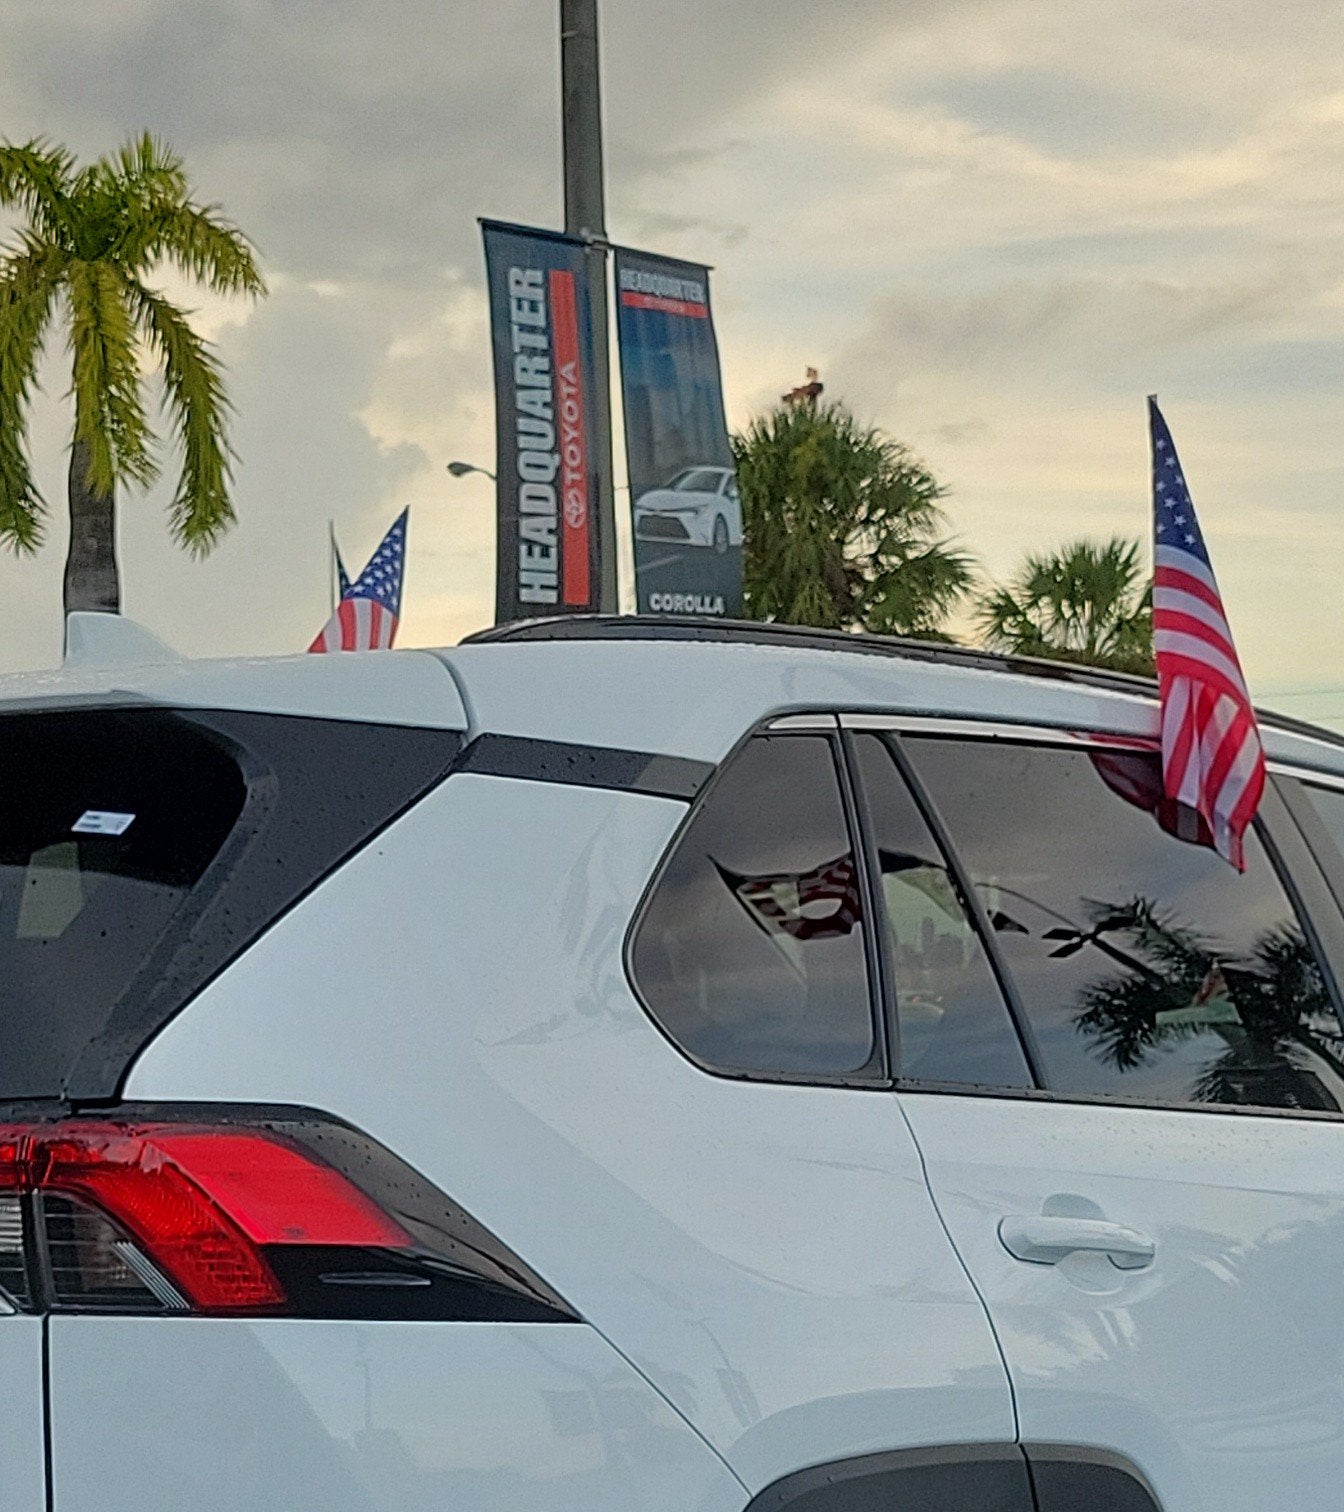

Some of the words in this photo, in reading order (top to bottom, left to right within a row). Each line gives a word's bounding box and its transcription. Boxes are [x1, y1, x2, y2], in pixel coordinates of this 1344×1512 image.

[508, 267, 560, 604] HEADQUARTER
[560, 363, 583, 485] TOYOTA
[649, 593, 725, 615] COROLLA
